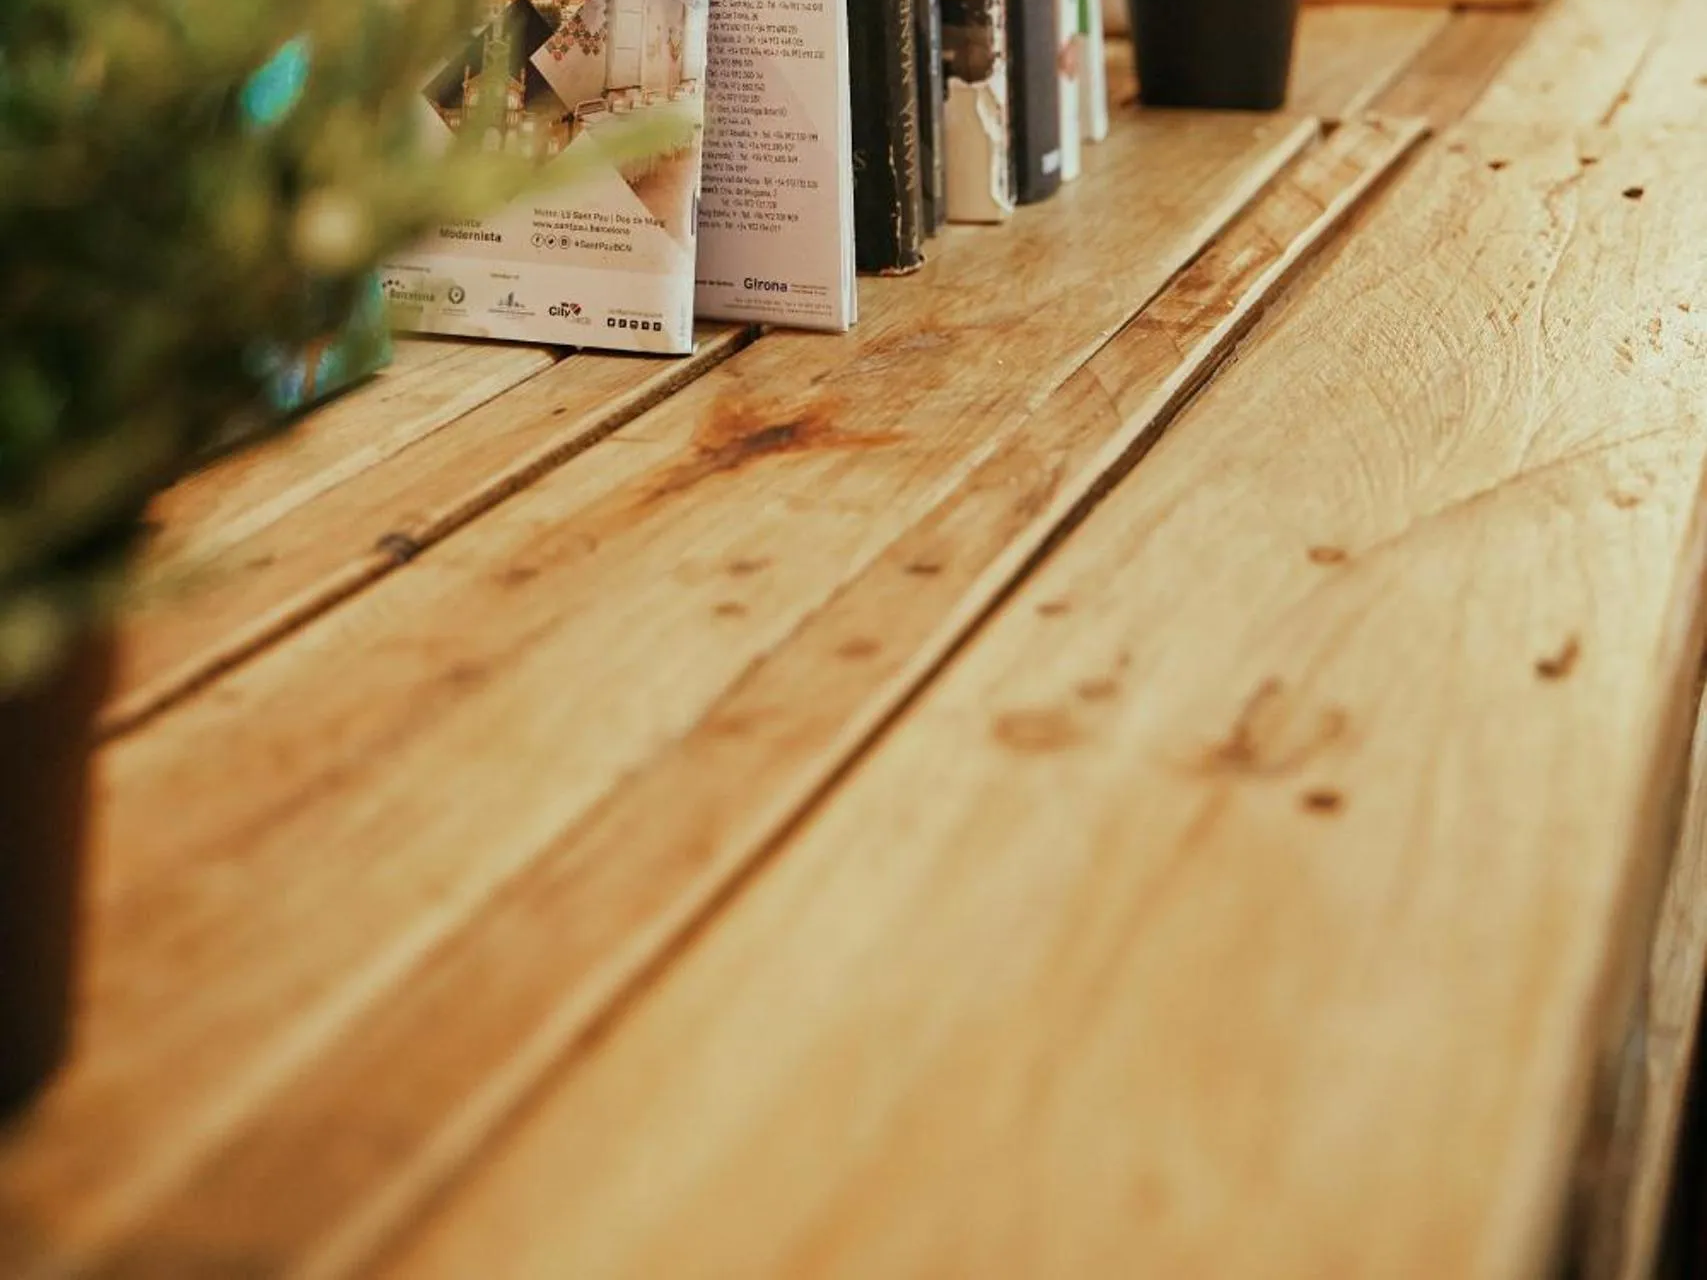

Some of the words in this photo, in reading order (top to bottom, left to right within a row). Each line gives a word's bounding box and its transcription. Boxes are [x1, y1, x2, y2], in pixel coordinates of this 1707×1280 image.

[439, 228, 502, 243] Modernista
[743, 277, 788, 293] Girona
[548, 306, 571, 318] City
